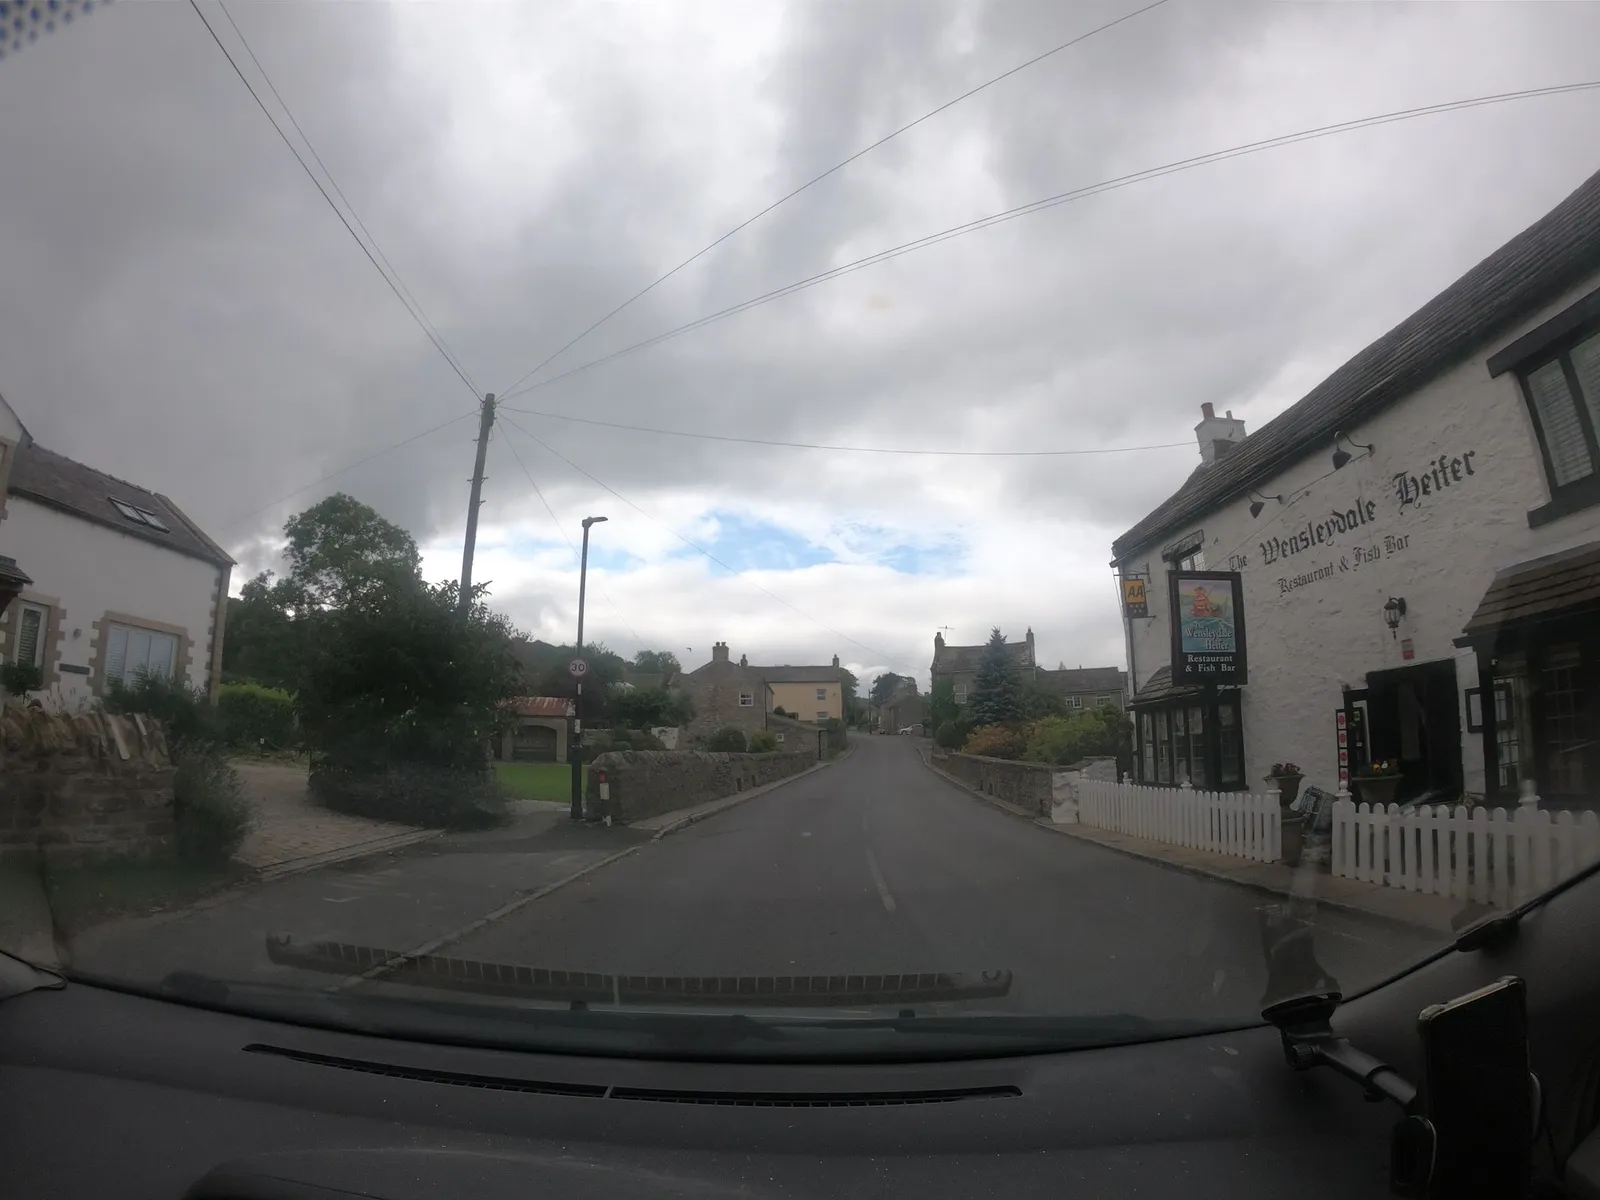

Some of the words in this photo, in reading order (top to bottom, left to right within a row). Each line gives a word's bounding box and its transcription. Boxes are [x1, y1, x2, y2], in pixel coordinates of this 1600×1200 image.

[1228, 554, 1248, 572] The
[1259, 497, 1377, 566] Wensleydale
[1392, 450, 1476, 516] Heifer
[1277, 562, 1335, 598] Restaurant
[1338, 555, 1350, 574] &
[1352, 545, 1382, 572] Fish
[1383, 533, 1410, 559] Bar
[1128, 586, 1144, 598] AA
[1185, 627, 1233, 640] Wensleydale
[1205, 639, 1229, 650] Heifer
[1187, 654, 1233, 663] Restaurant
[571, 663, 585, 672] 30
[1198, 663, 1216, 672] Fish
[1221, 663, 1236, 672] Bar
